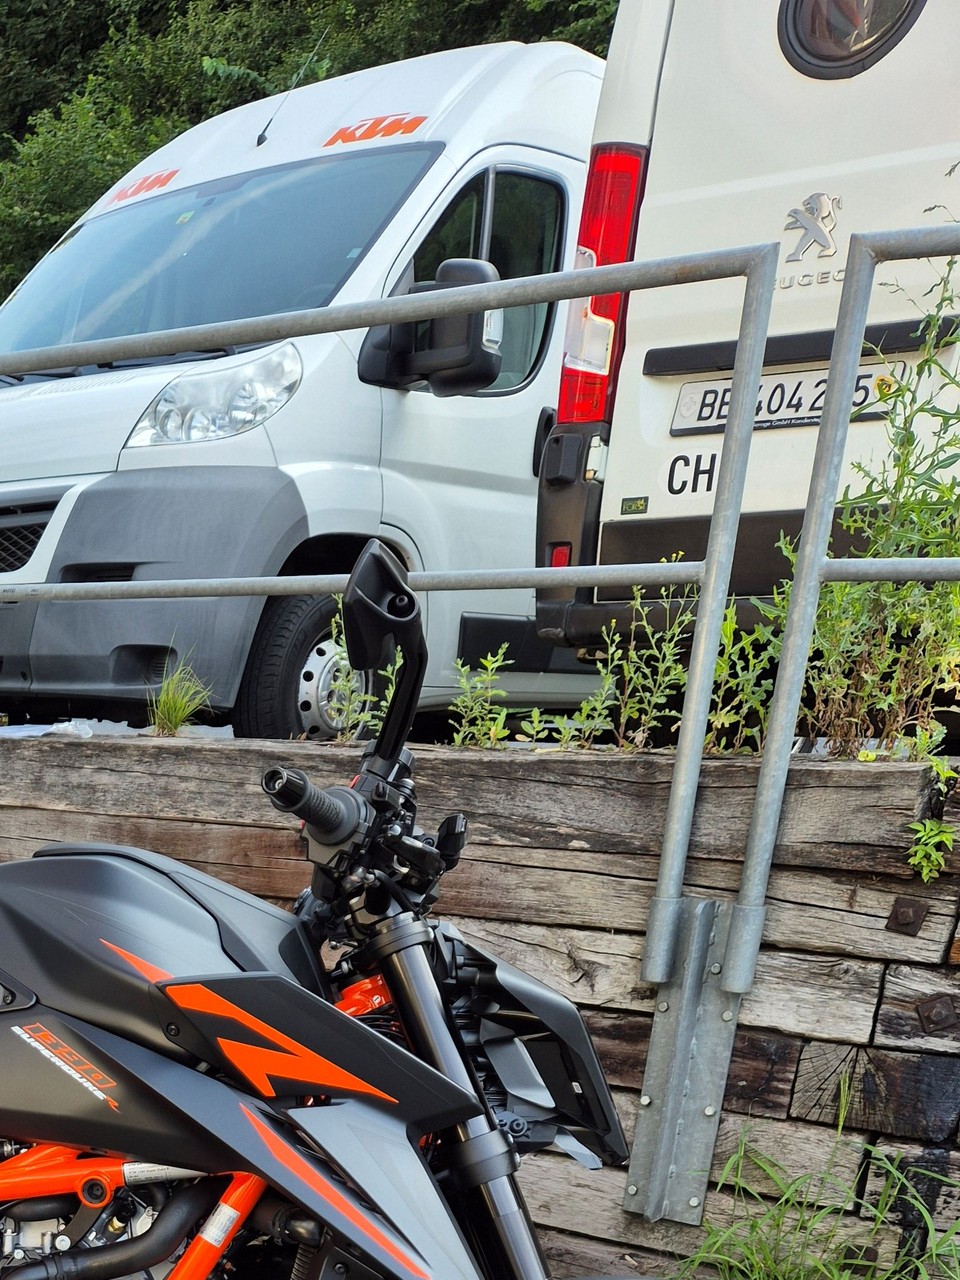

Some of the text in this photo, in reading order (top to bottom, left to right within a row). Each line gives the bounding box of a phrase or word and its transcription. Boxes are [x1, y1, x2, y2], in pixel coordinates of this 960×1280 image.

[321, 112, 429, 148] KTM
[105, 168, 181, 205] KTM
[773, 269, 845, 291] UGEO
[696, 388, 732, 422] BE
[808, 373, 874, 413] 25
[667, 452, 718, 495] CH
